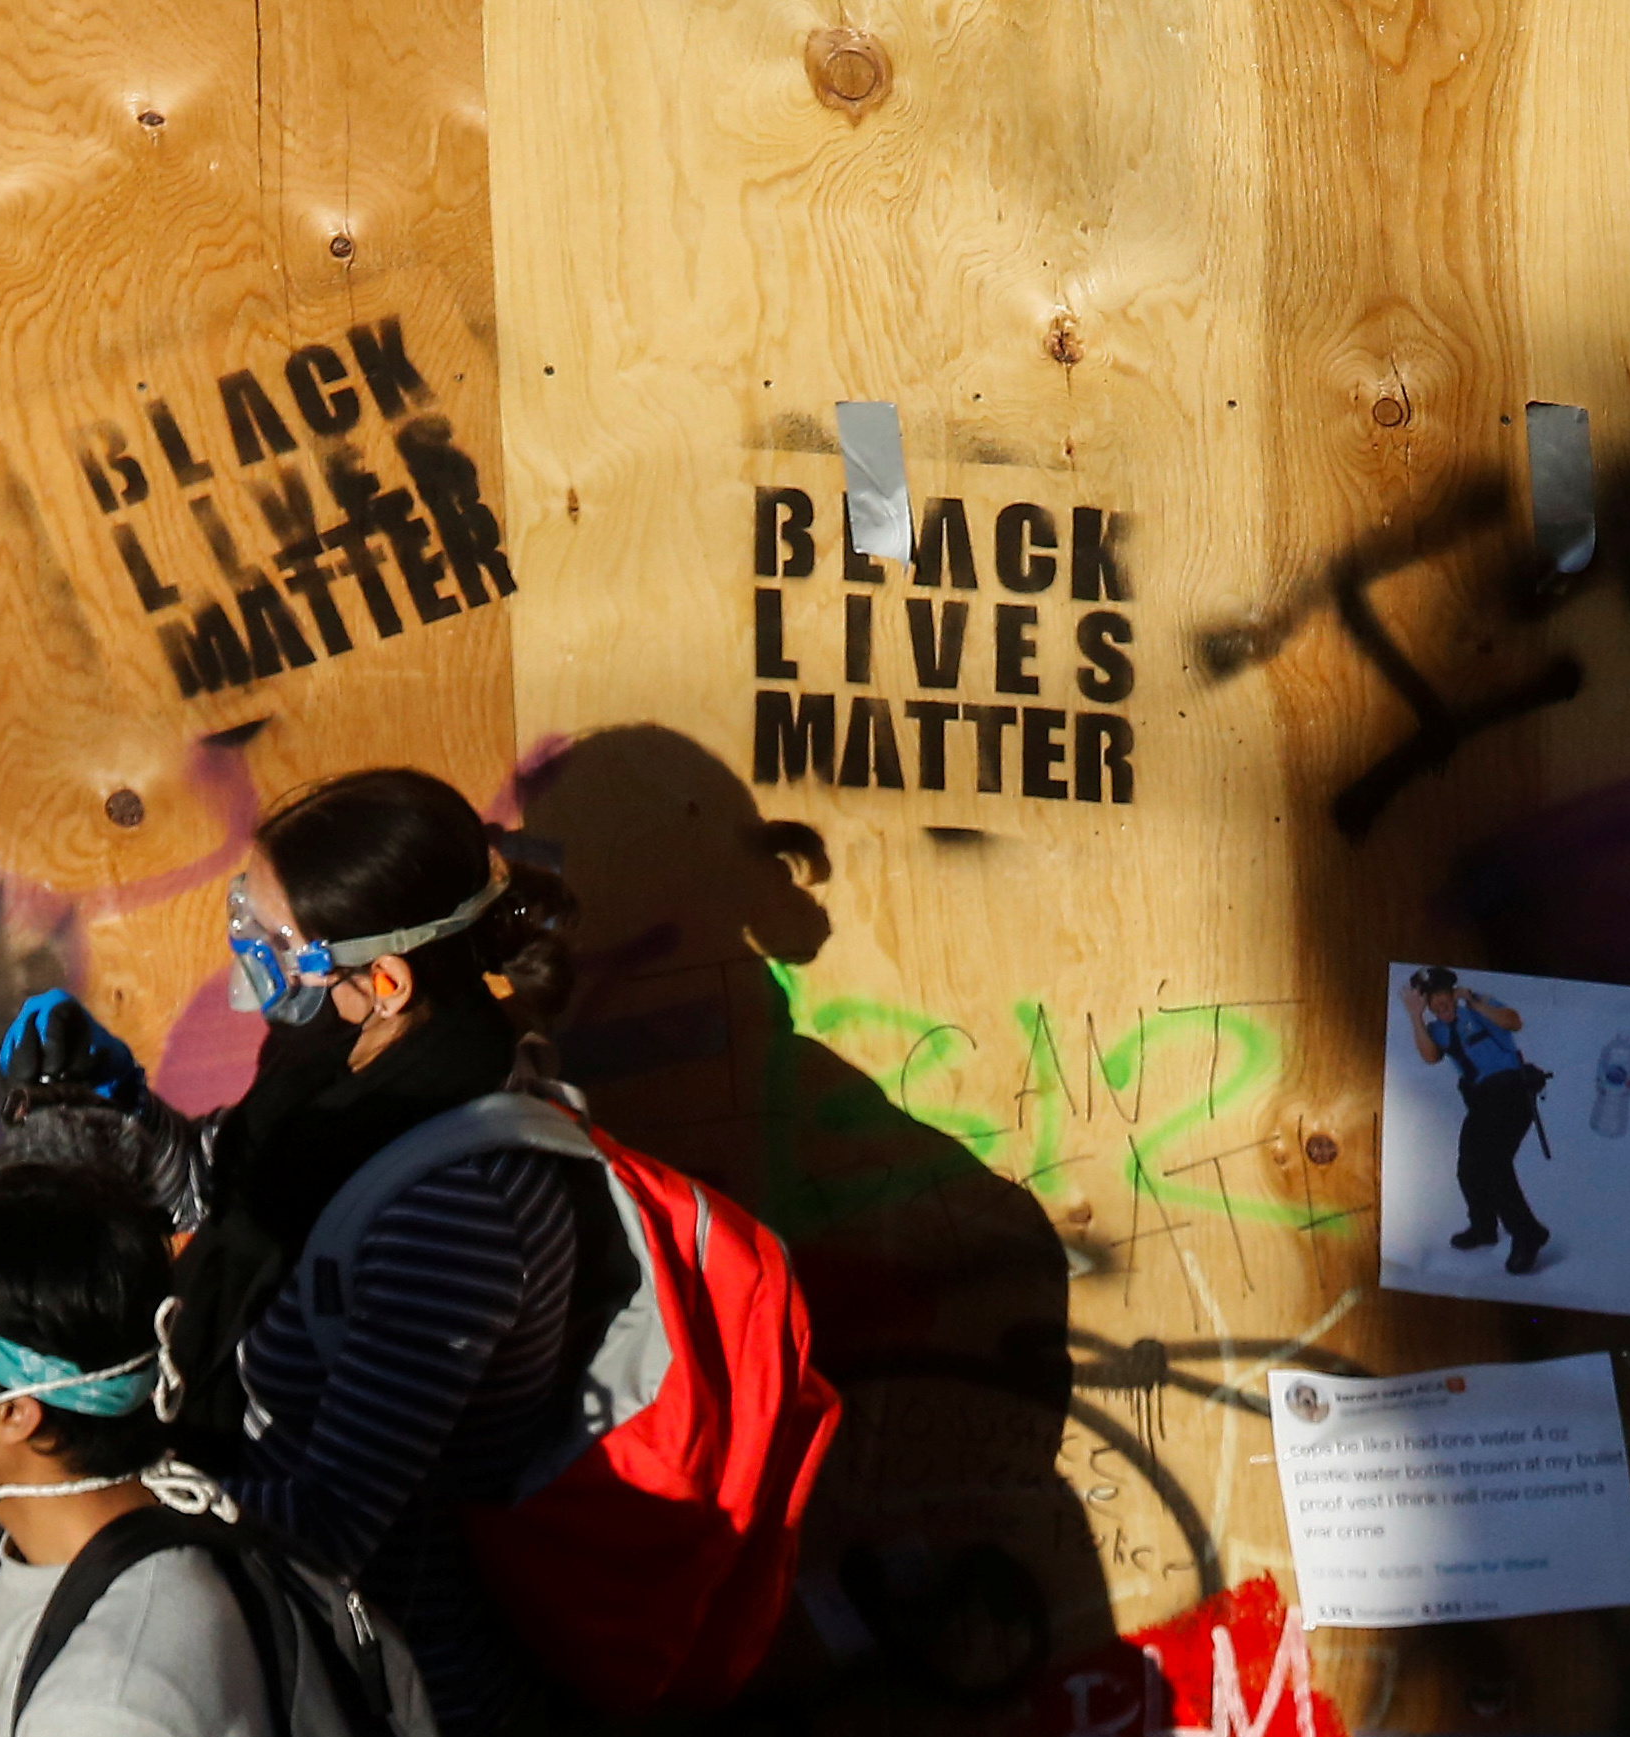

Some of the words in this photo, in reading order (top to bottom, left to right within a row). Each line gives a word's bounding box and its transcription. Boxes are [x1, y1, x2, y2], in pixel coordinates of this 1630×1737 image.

[71, 315, 437, 514] BLACK
[155, 472, 519, 699] MATTER
[755, 589, 1135, 706] LIVES
[752, 691, 1135, 804] MATTER
[1294, 1467, 1349, 1487] plastic
[1353, 1467, 1400, 1483] water
[1405, 1462, 1456, 1482] bottle
[1459, 1458, 1519, 1478] thrown
[1524, 1459, 1541, 1472] at
[1545, 1458, 1572, 1475] my
[1576, 1450, 1625, 1468] bullet
[1360, 1436, 1391, 1453] like
[1402, 1433, 1438, 1451] had
[1441, 1435, 1475, 1449] one
[1478, 1429, 1528, 1448] water
[1532, 1427, 1543, 1441] 4
[1299, 1494, 1344, 1514] proof
[1347, 1494, 1383, 1510] vest
[1396, 1490, 1436, 1507] think
[1450, 1488, 1478, 1505] will
[1482, 1487, 1519, 1504] now
[1523, 1480, 1589, 1500] commit
[1304, 1527, 1333, 1541] war
[1336, 1524, 1386, 1540] crime
